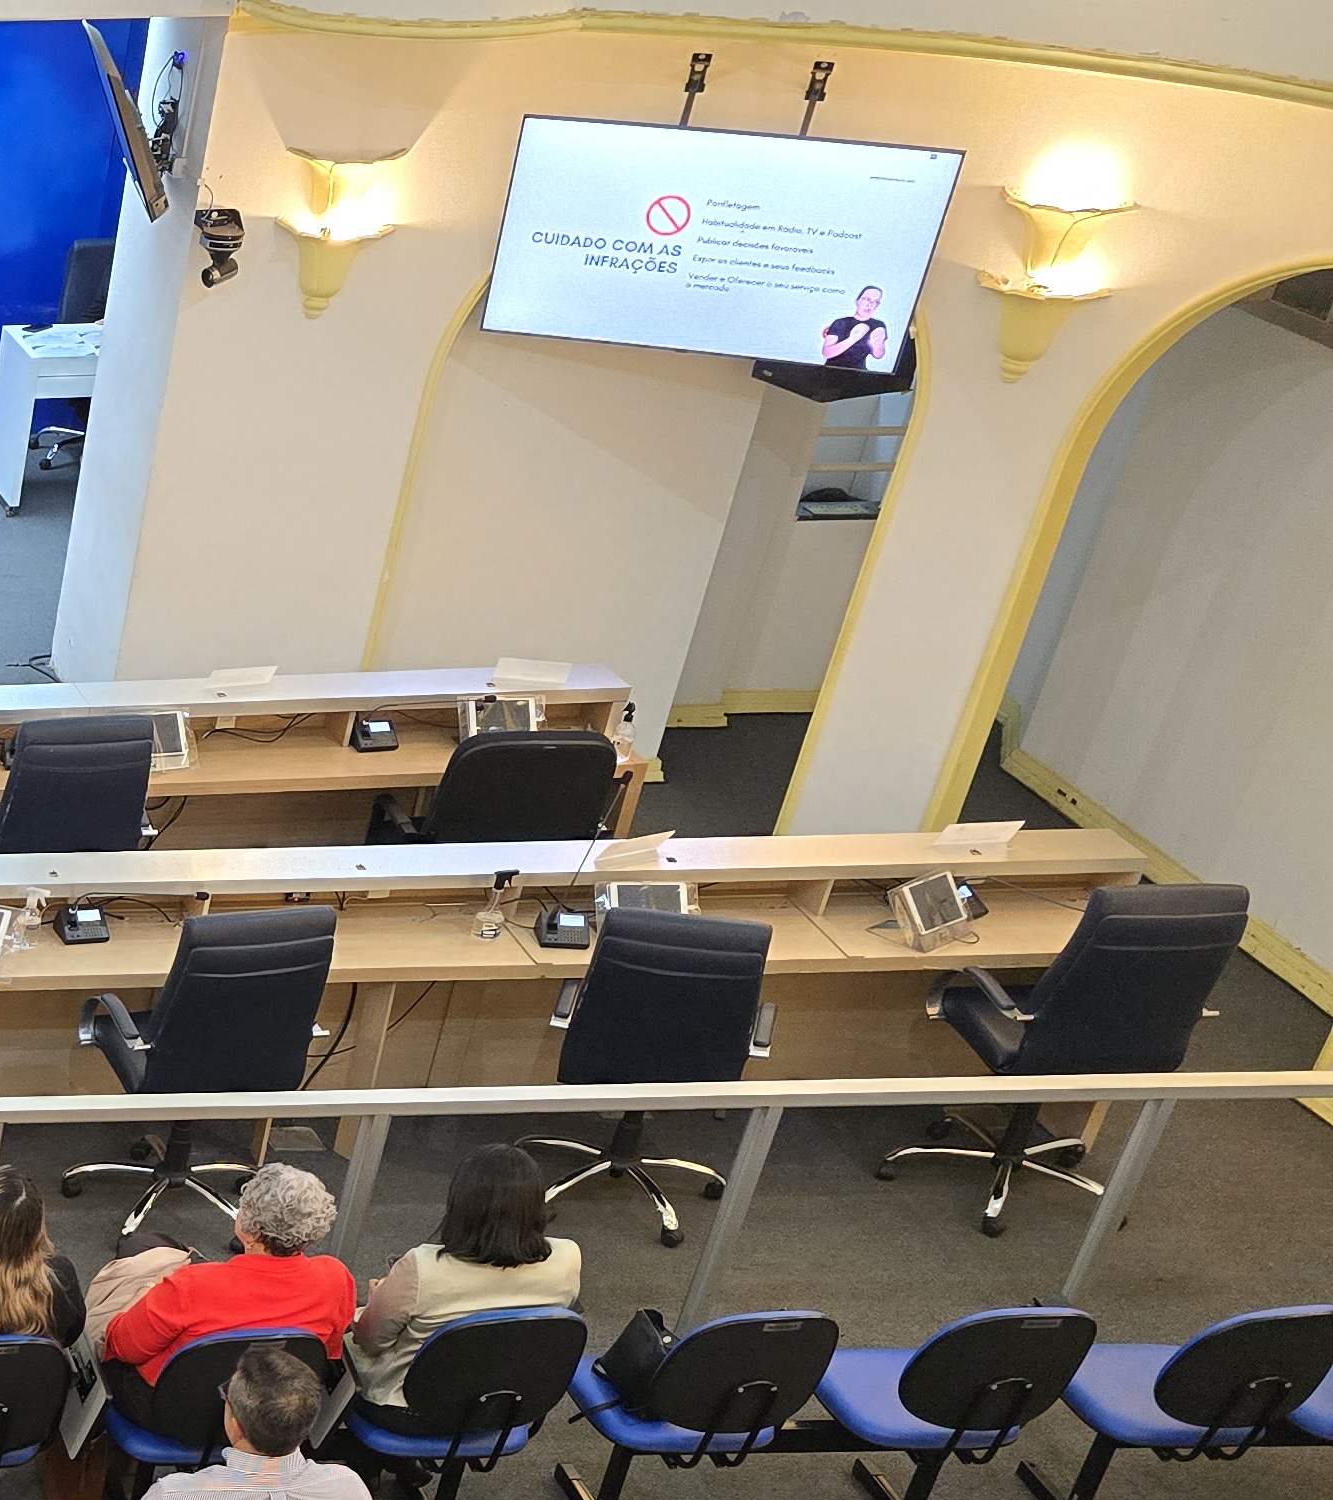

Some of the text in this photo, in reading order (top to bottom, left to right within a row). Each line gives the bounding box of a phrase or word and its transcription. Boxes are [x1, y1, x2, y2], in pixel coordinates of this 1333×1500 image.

[707, 199, 759, 211] Panfletagem
[702, 218, 760, 230] Habitualidade
[827, 230, 862, 240] Podcast
[532, 231, 682, 256] CUIDADO COM AS
[697, 236, 730, 246] Publicar
[584, 254, 678, 274] INFRAÇÕES
[693, 255, 716, 263] Expor
[730, 258, 761, 268] clientes
[792, 264, 834, 275] feedbacks
[688, 272, 718, 281] Vender
[822, 286, 845, 294] como
[693, 284, 729, 292] mercado
